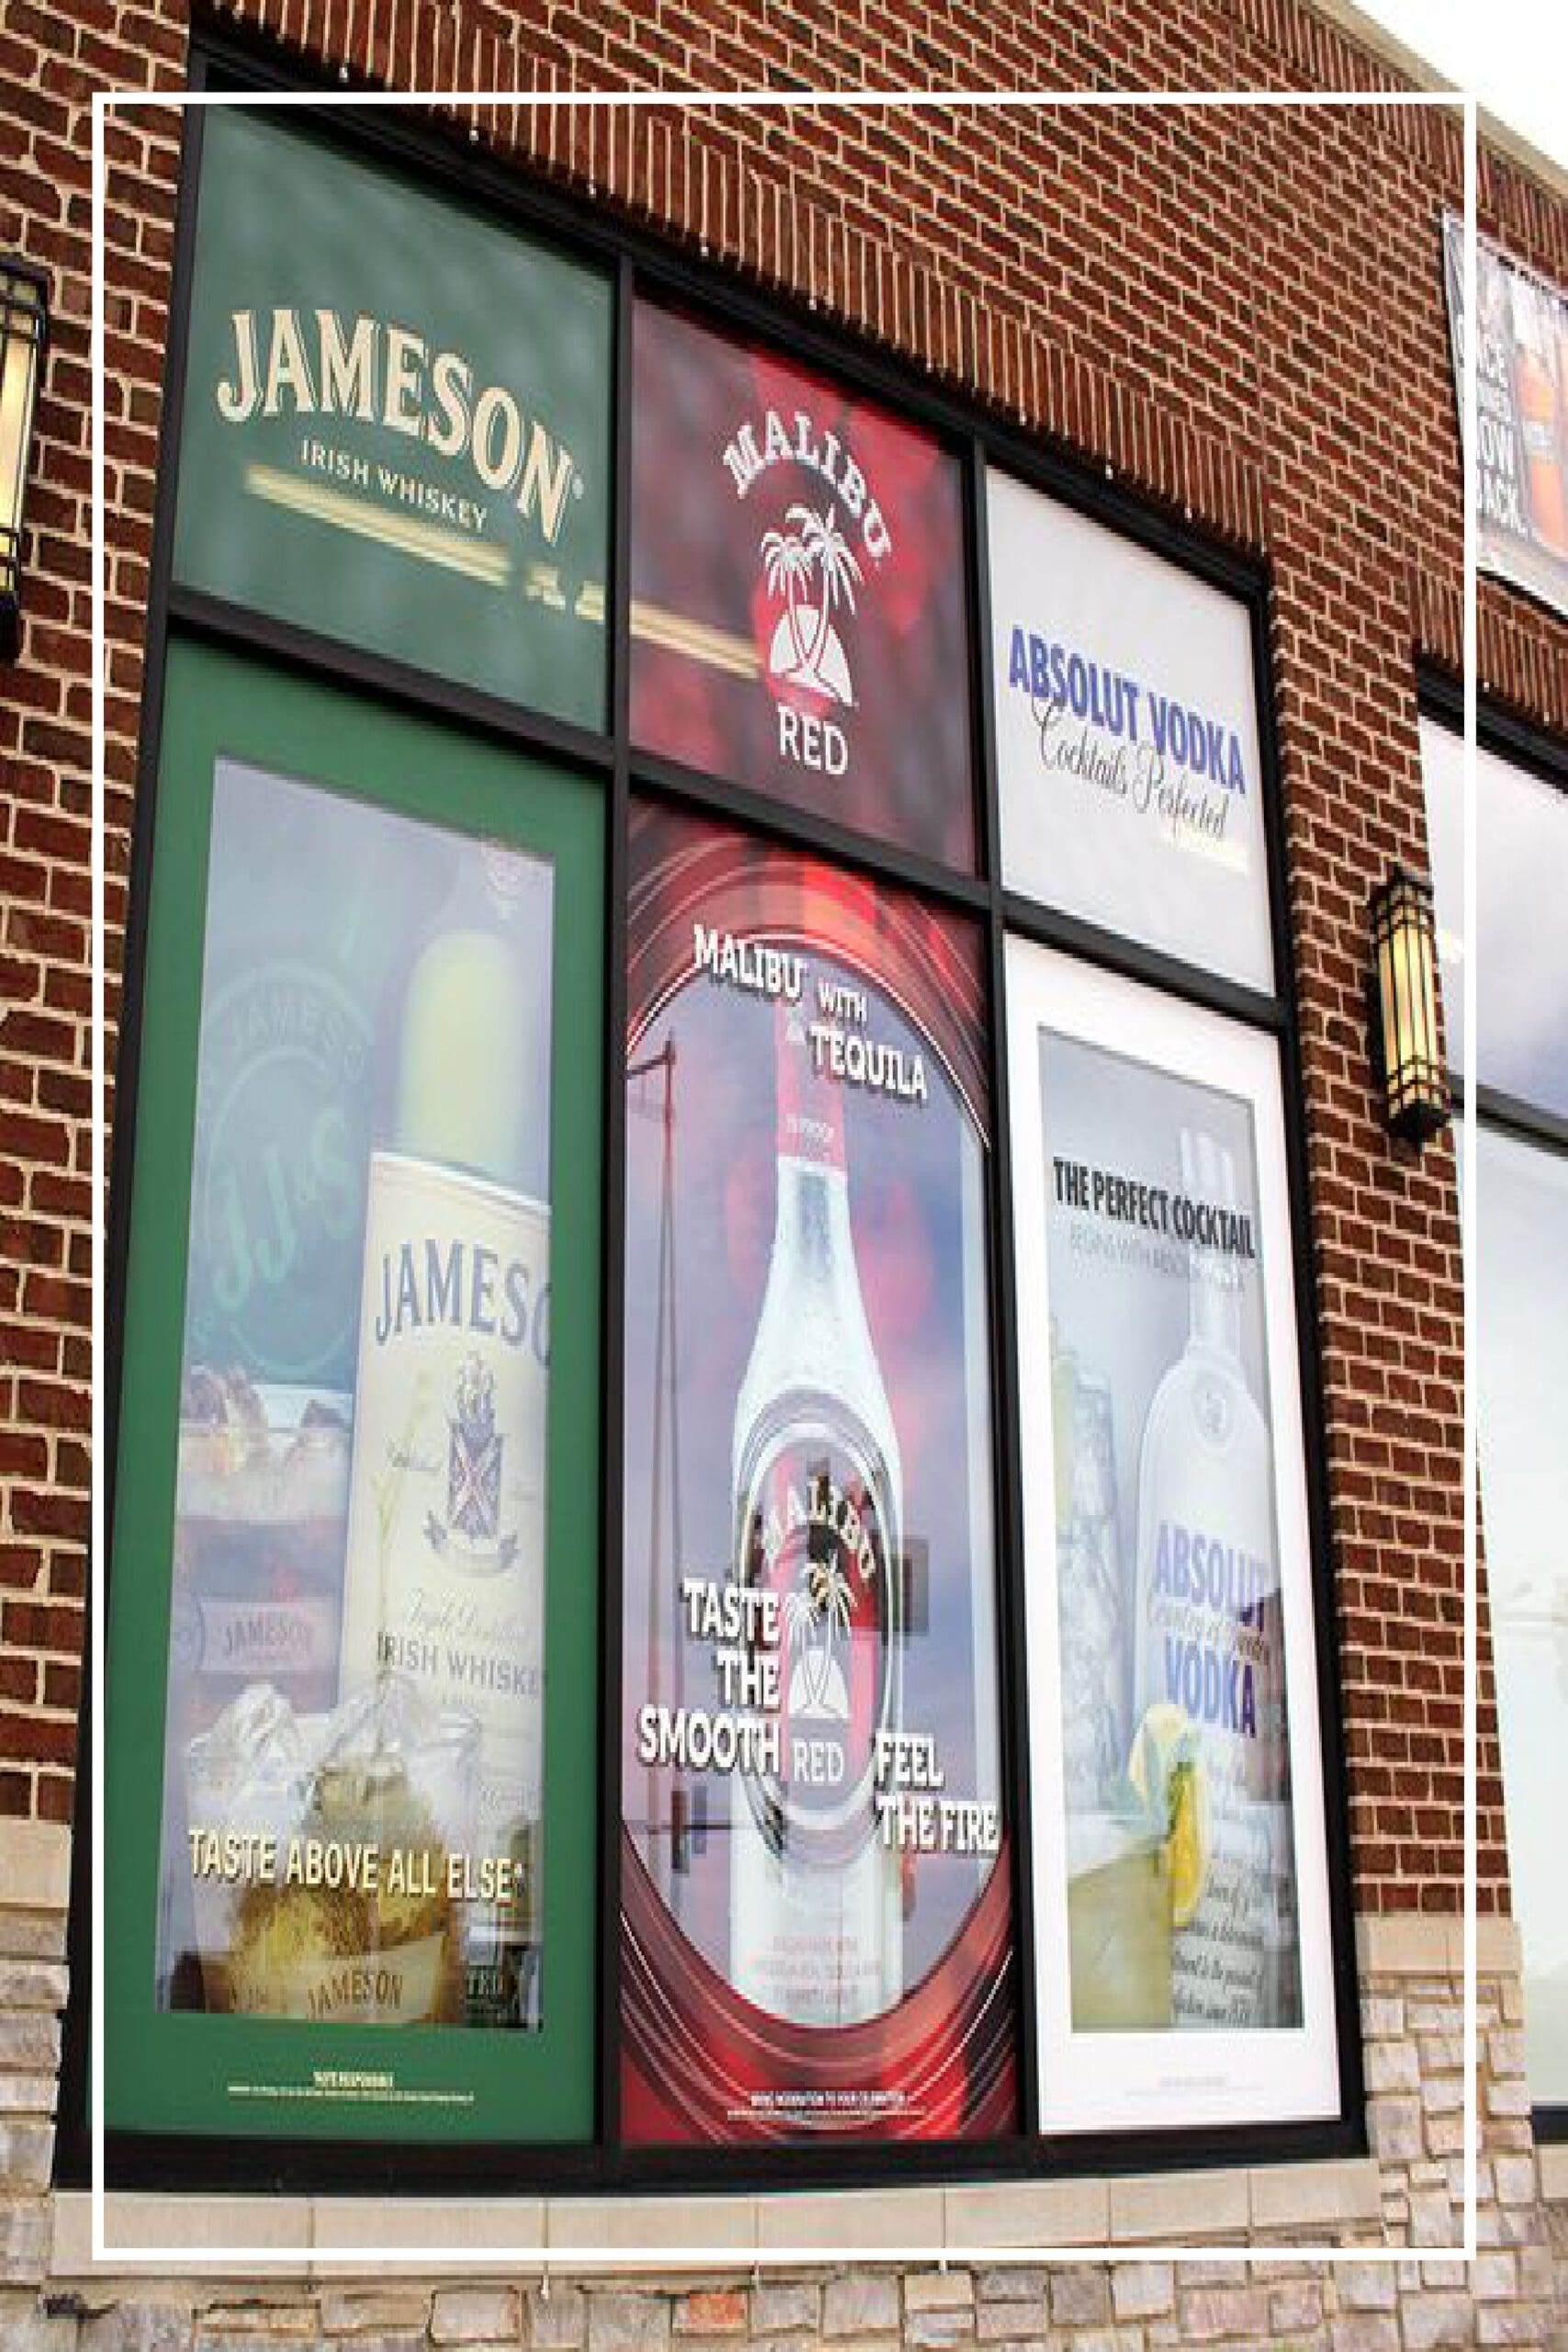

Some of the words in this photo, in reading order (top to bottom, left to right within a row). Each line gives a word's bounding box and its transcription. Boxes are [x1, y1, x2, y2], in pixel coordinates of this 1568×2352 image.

[216, 309, 574, 547] JAMESON
[301, 438, 369, 485] IRISH
[378, 465, 488, 530] WHISKEY
[723, 411, 893, 558] MALIBU
[777, 702, 850, 775] RED
[1010, 624, 1140, 745] ABSOLUT
[1148, 691, 1246, 795] VODKA
[1031, 695, 1128, 795] Cocktails
[1133, 740, 1230, 841] Perfected
[694, 923, 804, 999] MALIBU
[818, 981, 869, 1023] WITH
[809, 1024, 929, 1100] TEQUILA
[1054, 1156, 1089, 1211] THE
[1091, 1170, 1168, 1234] PERFECT
[1173, 1194, 1256, 1260] COCKTAIL
[682, 1577, 780, 1639] TASTE
[377, 1630, 437, 1675] IRISH
[716, 1652, 779, 1705] THE
[1165, 1634, 1257, 1739] VODKA
[639, 1707, 780, 1772] SMOOTH
[793, 1742, 845, 1782] RED
[875, 1732, 944, 1784] FEEL
[876, 1795, 934, 1849] THE
[939, 1800, 998, 1850] FIRE
[188, 1829, 276, 1880] TASTE
[287, 1838, 379, 1889] ABOVE
[387, 1849, 437, 1894] ALL
